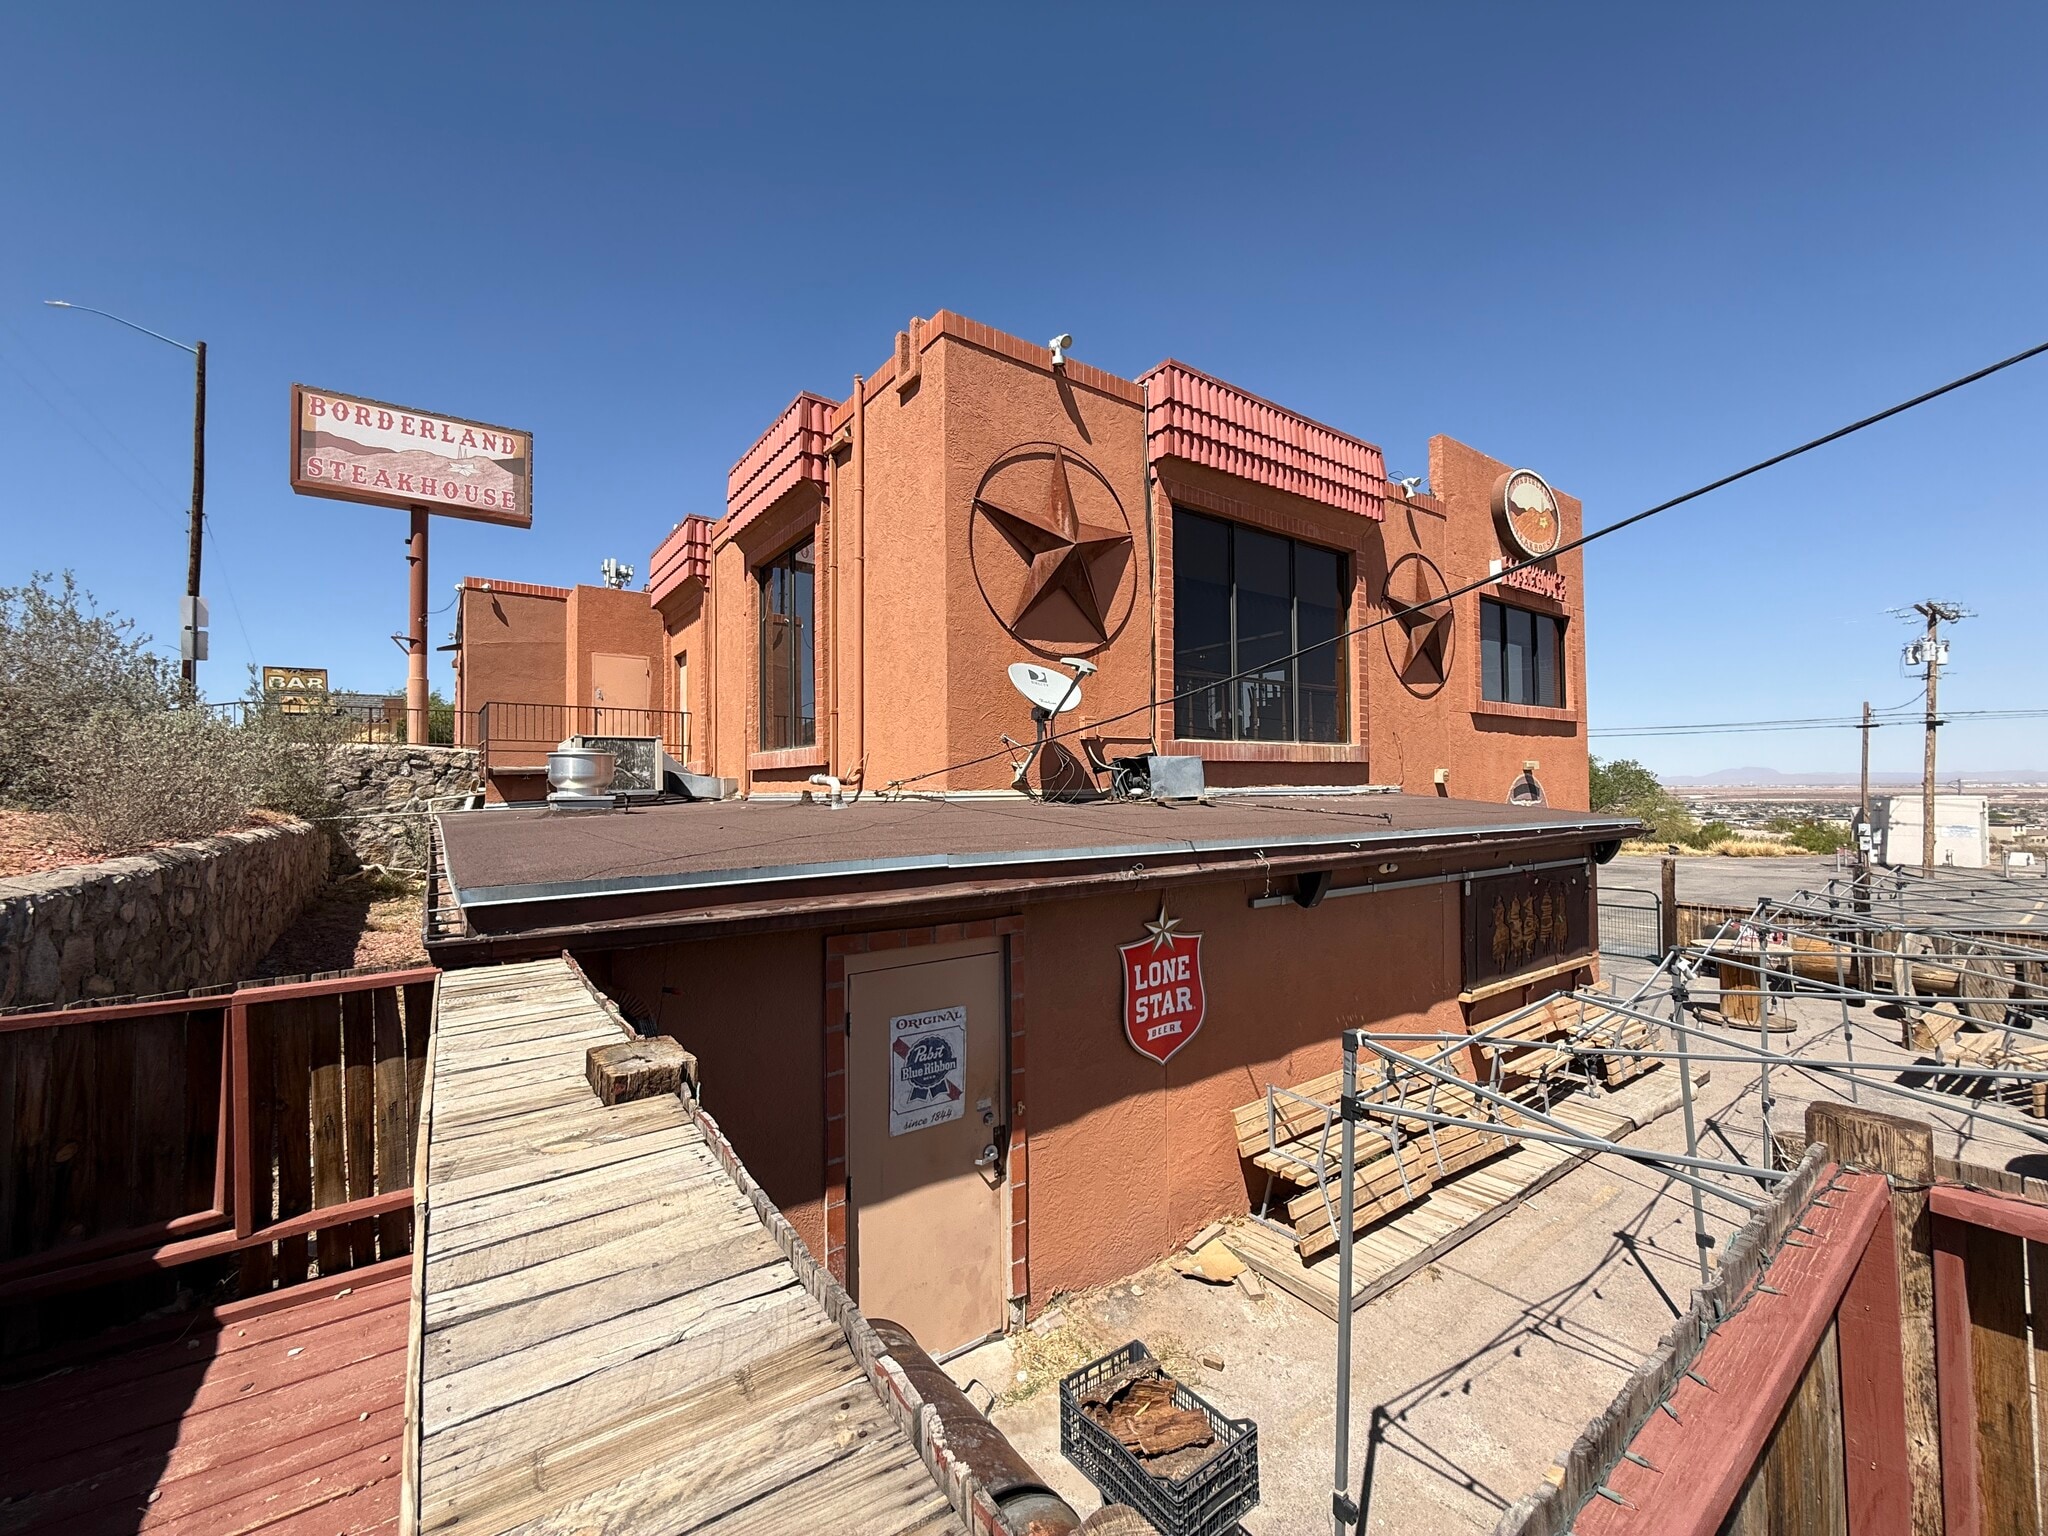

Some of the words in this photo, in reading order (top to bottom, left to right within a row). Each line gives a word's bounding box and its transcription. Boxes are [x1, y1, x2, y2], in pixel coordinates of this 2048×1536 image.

[309, 395, 517, 455] BORDERLAND
[307, 457, 516, 511] STEAKHOUSE
[268, 676, 324, 689] BAR
[1134, 955, 1190, 991] LONE
[1135, 986, 1192, 1024] STAR
[896, 1011, 962, 1030] ORIGINAL
[1151, 1023, 1176, 1038] BEER
[911, 1044, 946, 1063] Pabst
[902, 1067, 923, 1080] Blue
[923, 1060, 956, 1076] Ribbon
[904, 1118, 928, 1130] since
[930, 1108, 953, 1123] 1844
